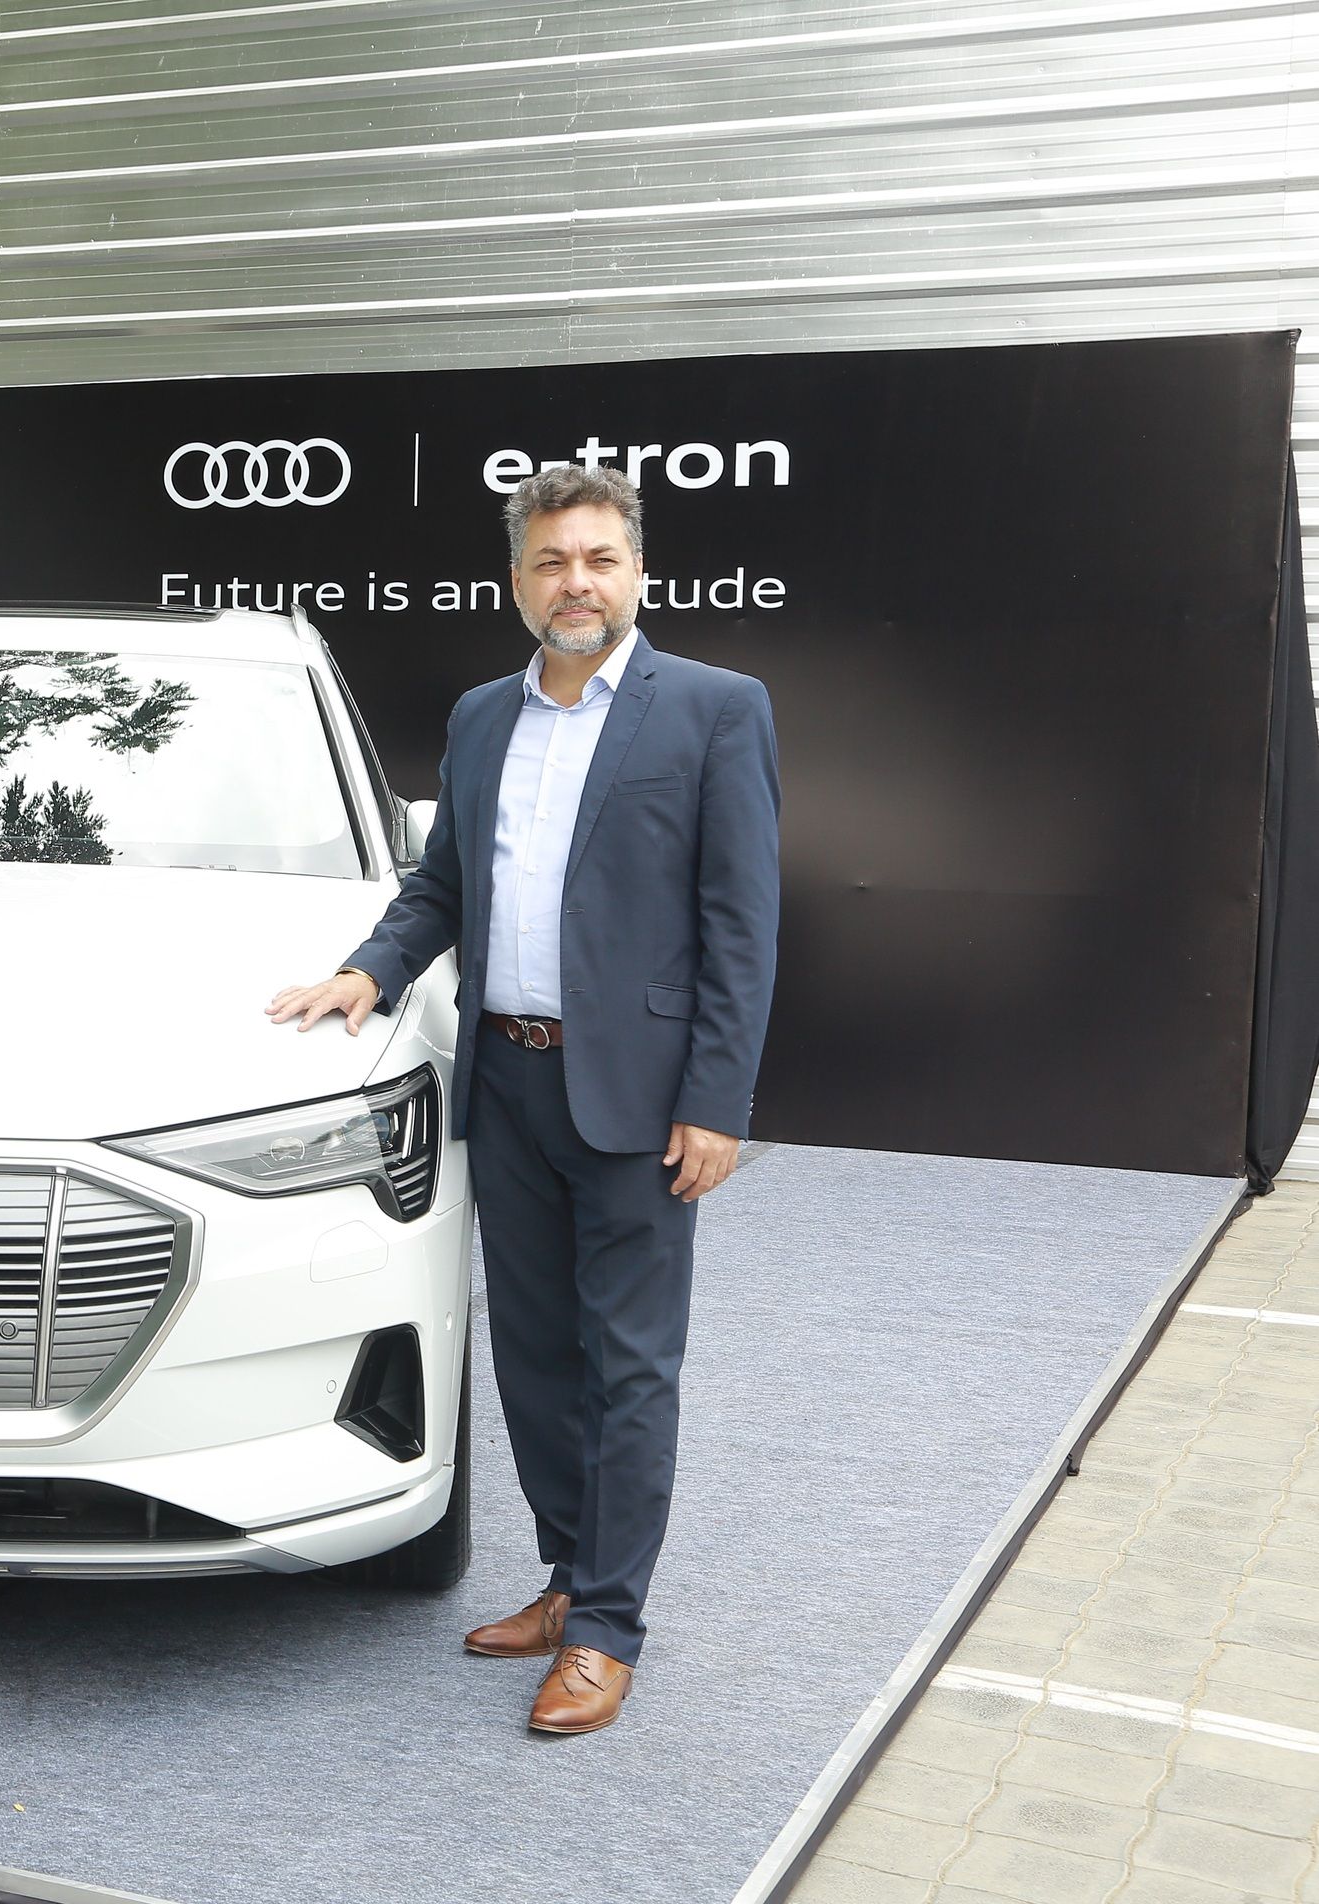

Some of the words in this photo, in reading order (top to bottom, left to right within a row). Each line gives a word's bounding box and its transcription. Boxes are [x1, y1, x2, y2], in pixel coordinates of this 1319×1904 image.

[482, 436, 790, 494] e-tron
[161, 571, 346, 612] Future
[368, 571, 409, 612] is
[431, 581, 501, 611] an
[641, 567, 787, 610] tude
